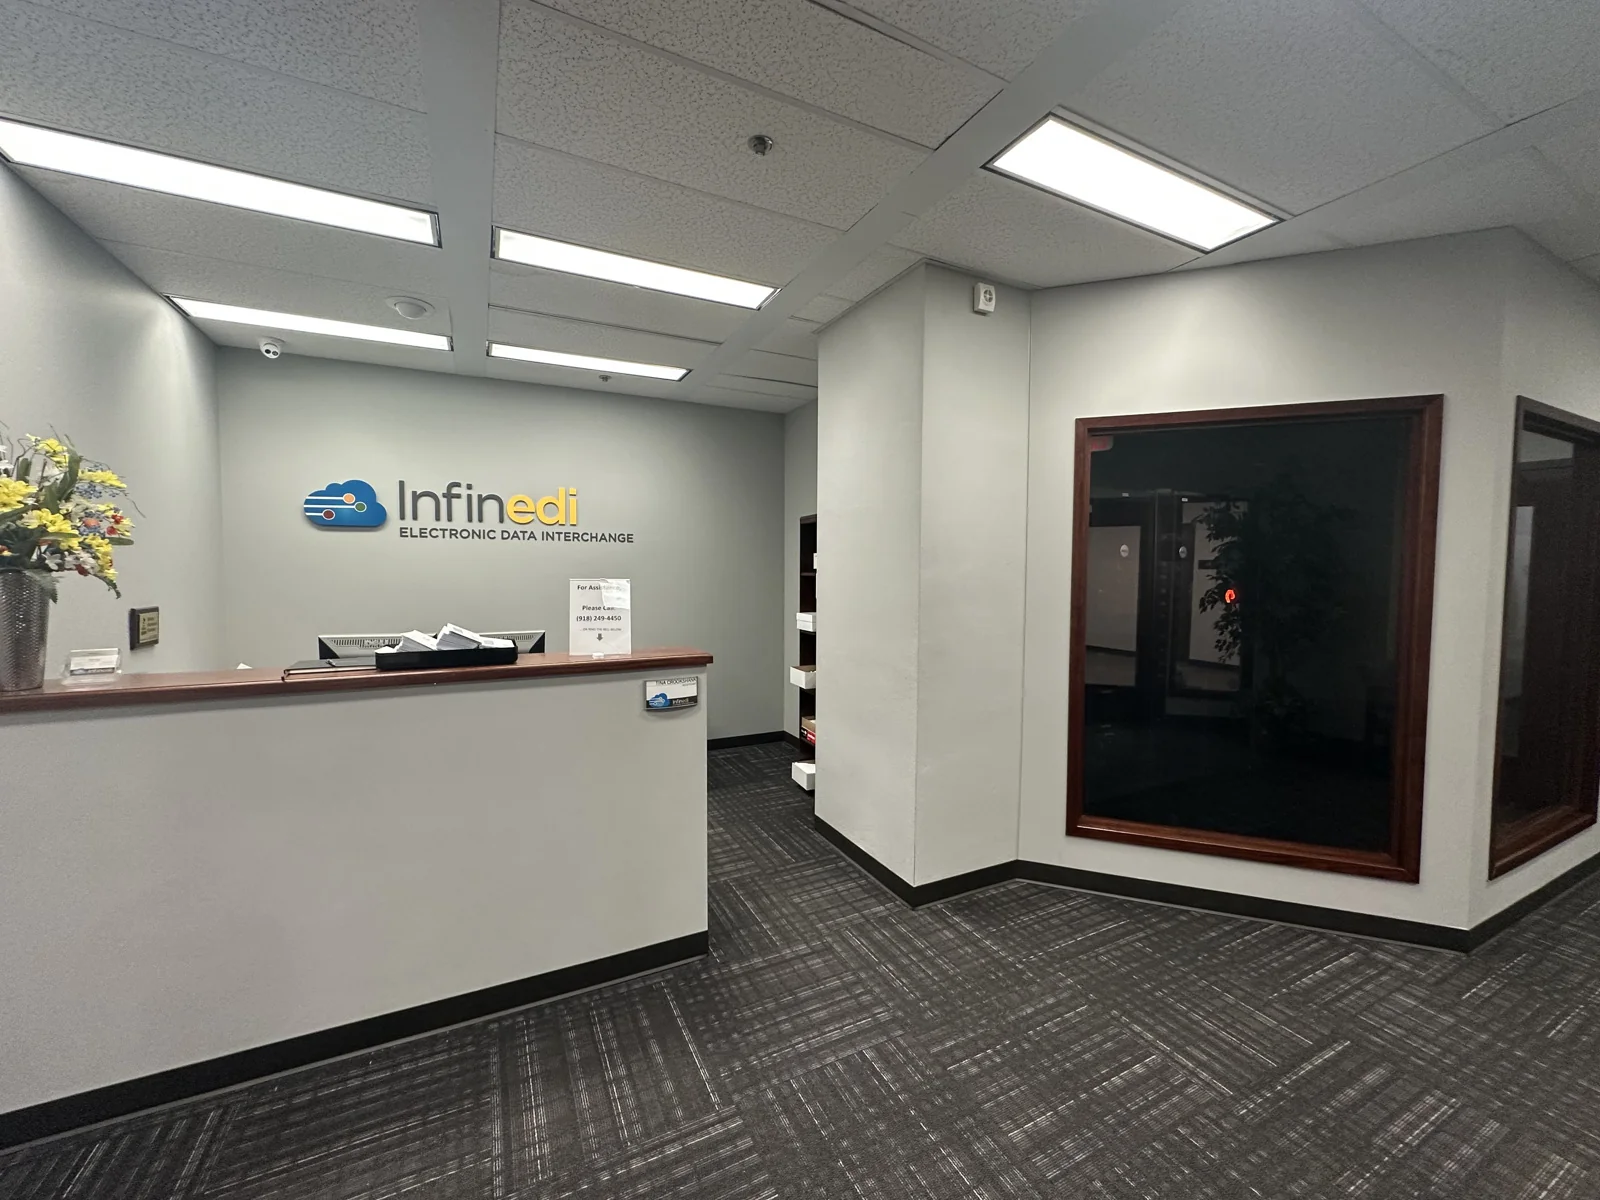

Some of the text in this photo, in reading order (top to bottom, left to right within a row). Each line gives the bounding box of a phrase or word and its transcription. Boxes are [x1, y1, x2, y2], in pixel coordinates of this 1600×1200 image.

[398, 480, 577, 526] Infinedi
[399, 527, 634, 543] ELECTRONIC DATA INTERCHANGE
